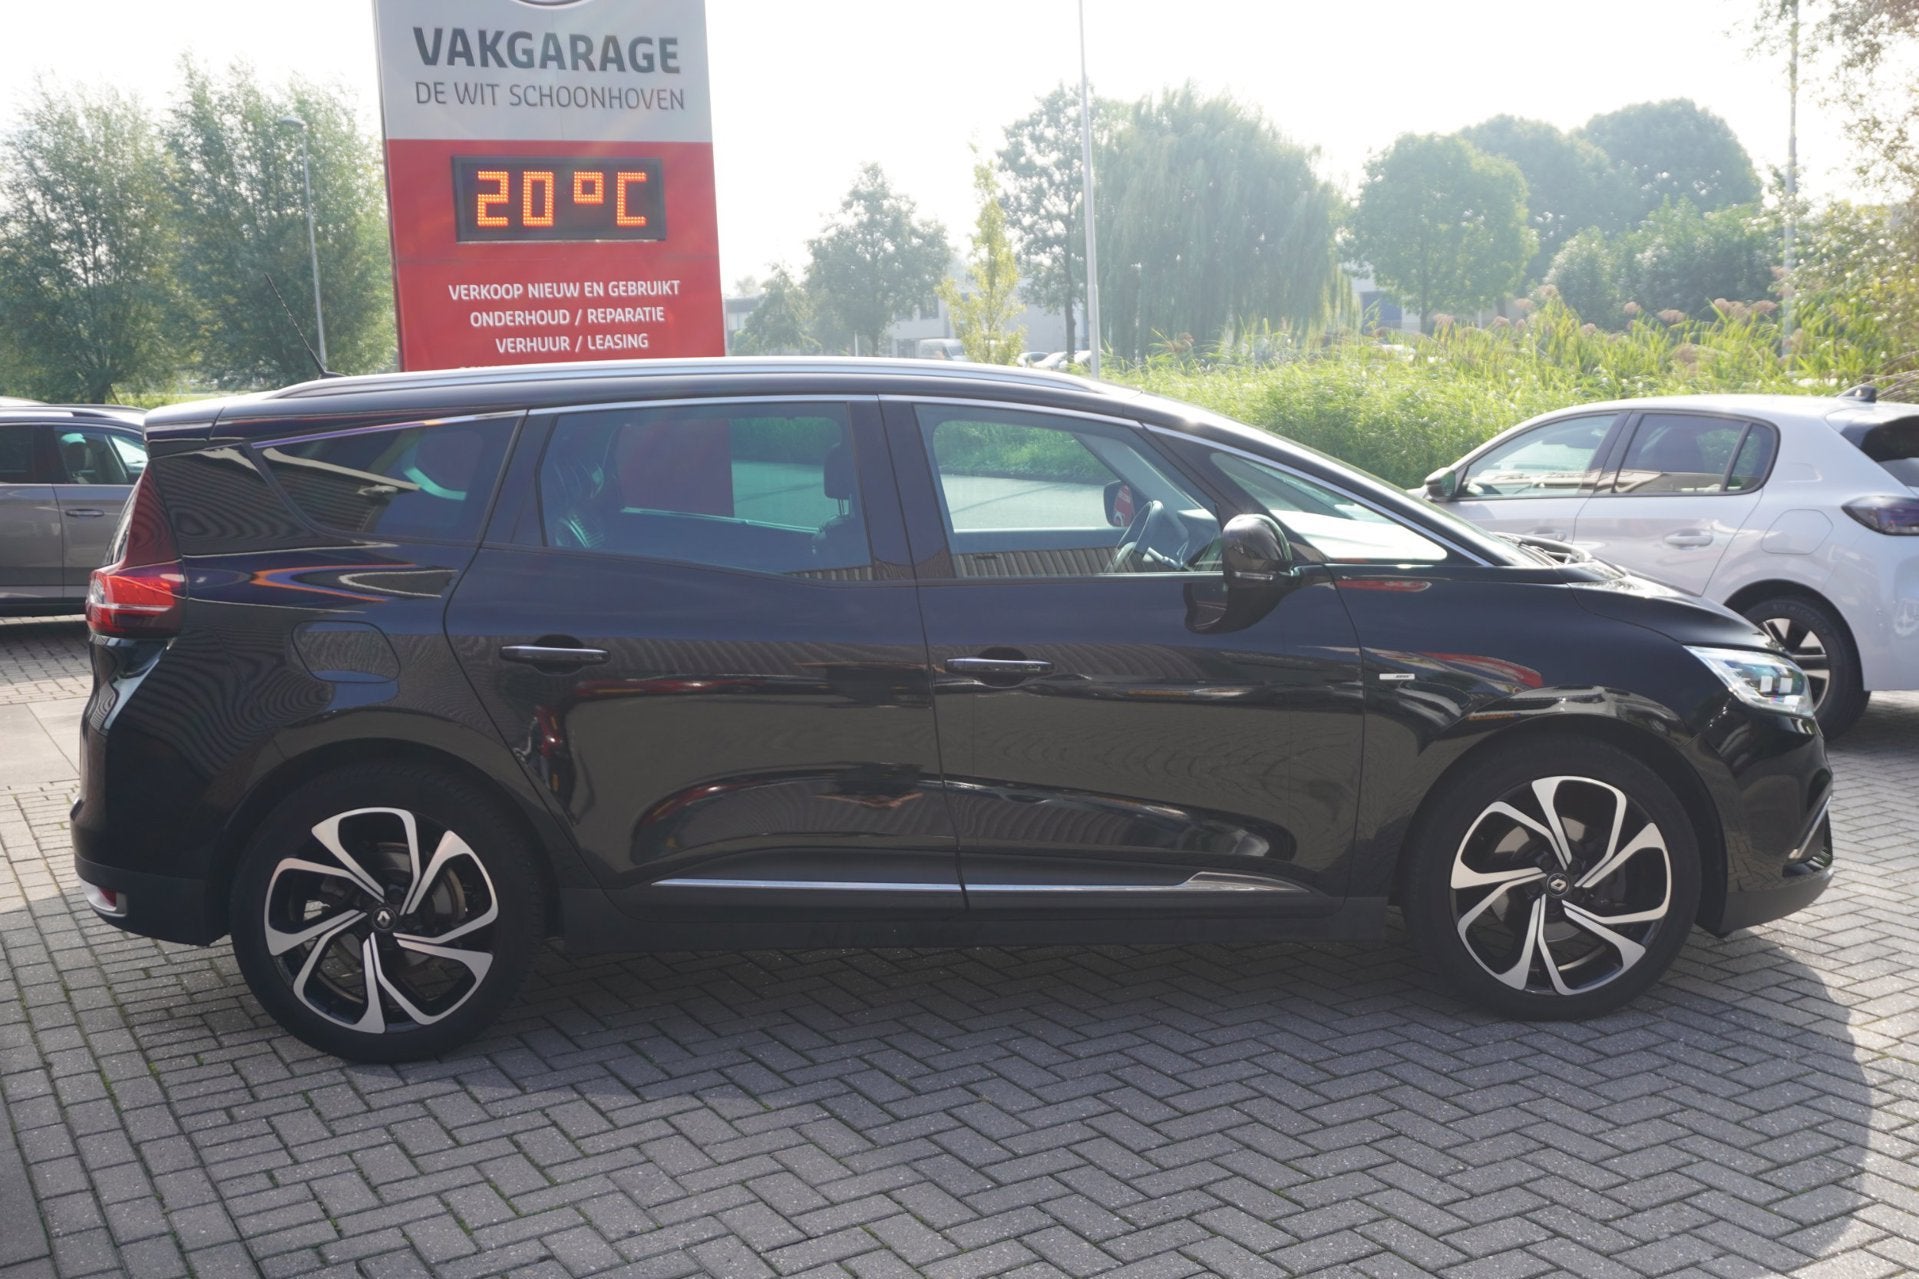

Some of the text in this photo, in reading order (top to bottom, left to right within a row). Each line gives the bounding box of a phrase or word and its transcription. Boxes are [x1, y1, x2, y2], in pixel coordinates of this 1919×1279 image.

[412, 26, 682, 75] VAKGARAGE
[415, 81, 686, 111] DE WIT SCHOONHOVEN
[448, 279, 681, 301] VERKOOP NIEUW EN GEBRUIKT
[469, 308, 571, 328] ONDERHOUD
[587, 306, 666, 324] REPARATIE
[495, 336, 571, 354] VERHUUR
[587, 332, 649, 350] LEASING
